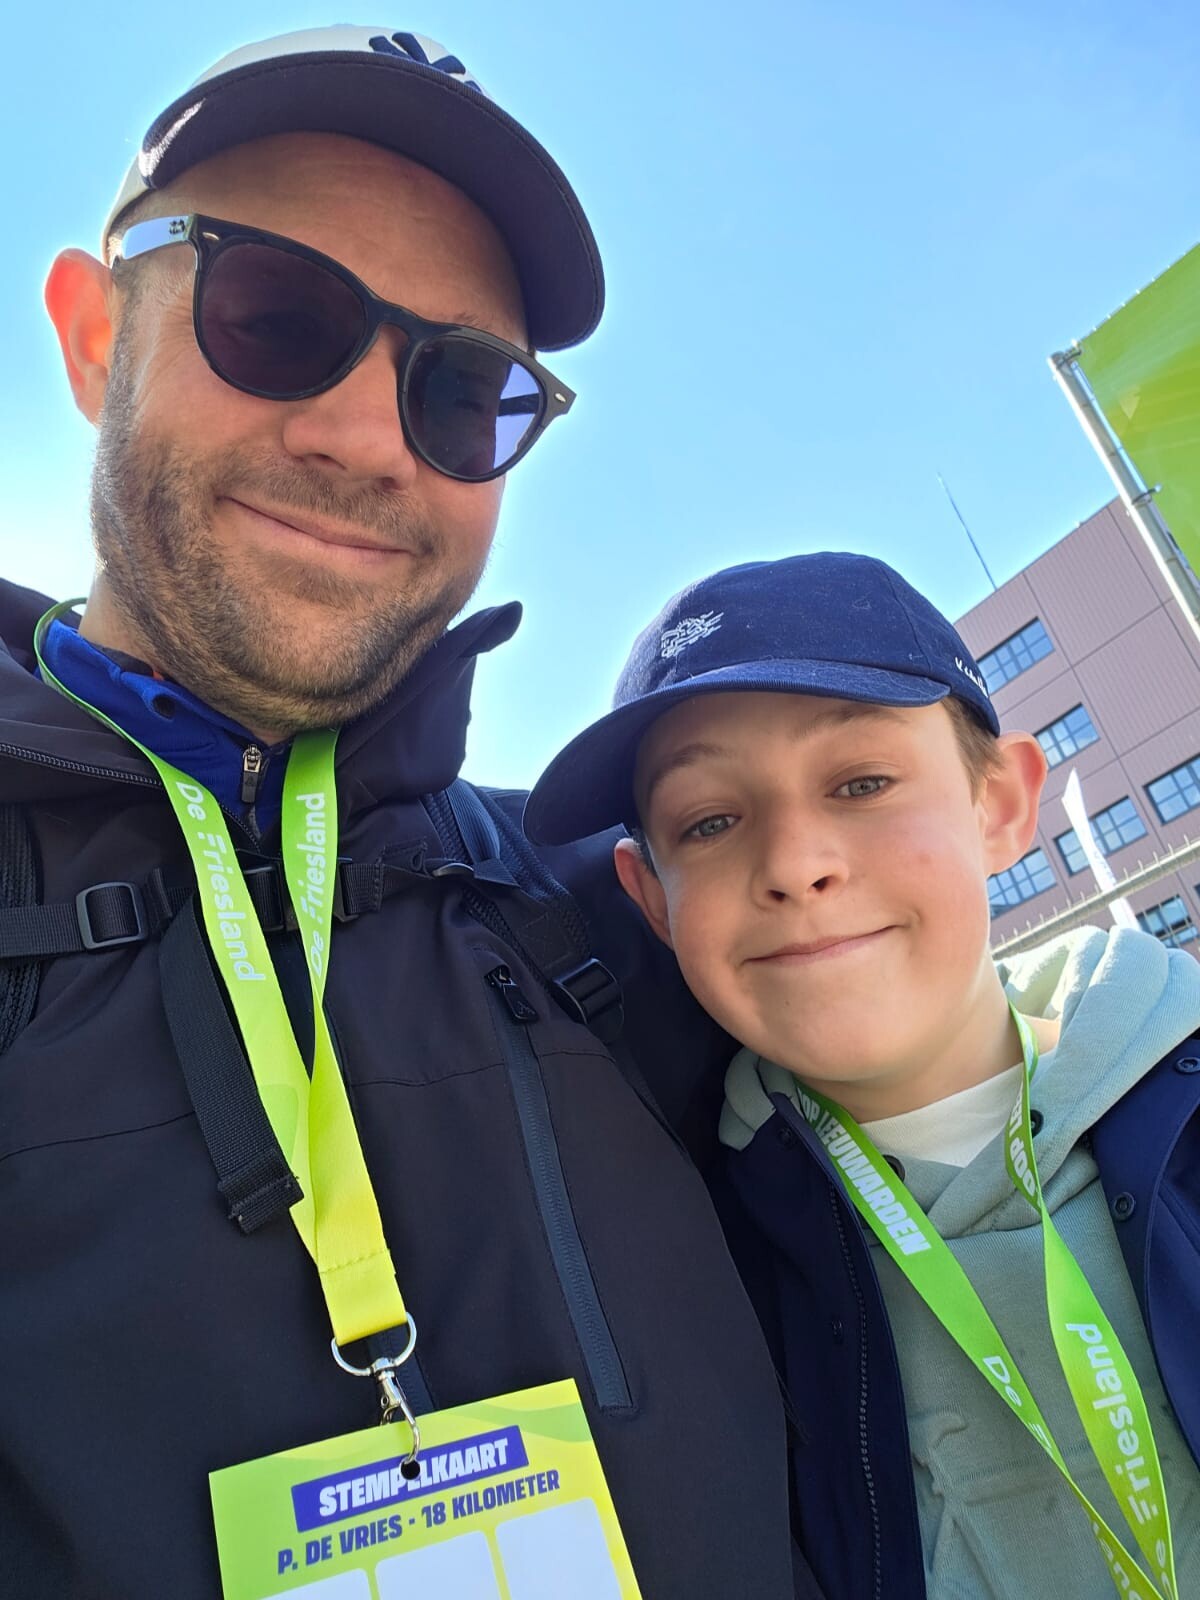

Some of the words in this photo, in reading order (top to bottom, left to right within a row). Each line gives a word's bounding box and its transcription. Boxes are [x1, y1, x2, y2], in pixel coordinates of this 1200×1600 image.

[176, 781, 207, 822] De
[197, 831, 265, 981] Friesland
[296, 792, 326, 924] Friesland
[311, 931, 326, 978] De
[814, 1110, 931, 1256] LEEUWARDEN
[982, 1355, 1022, 1407] De
[1065, 1322, 1160, 1525] Friesland
[277, 1548, 299, 1575] P.
[305, 1535, 333, 1566] DE
[340, 1514, 403, 1555] VRIES
[421, 1503, 447, 1530] 18
[452, 1468, 561, 1519] KILOMETER
